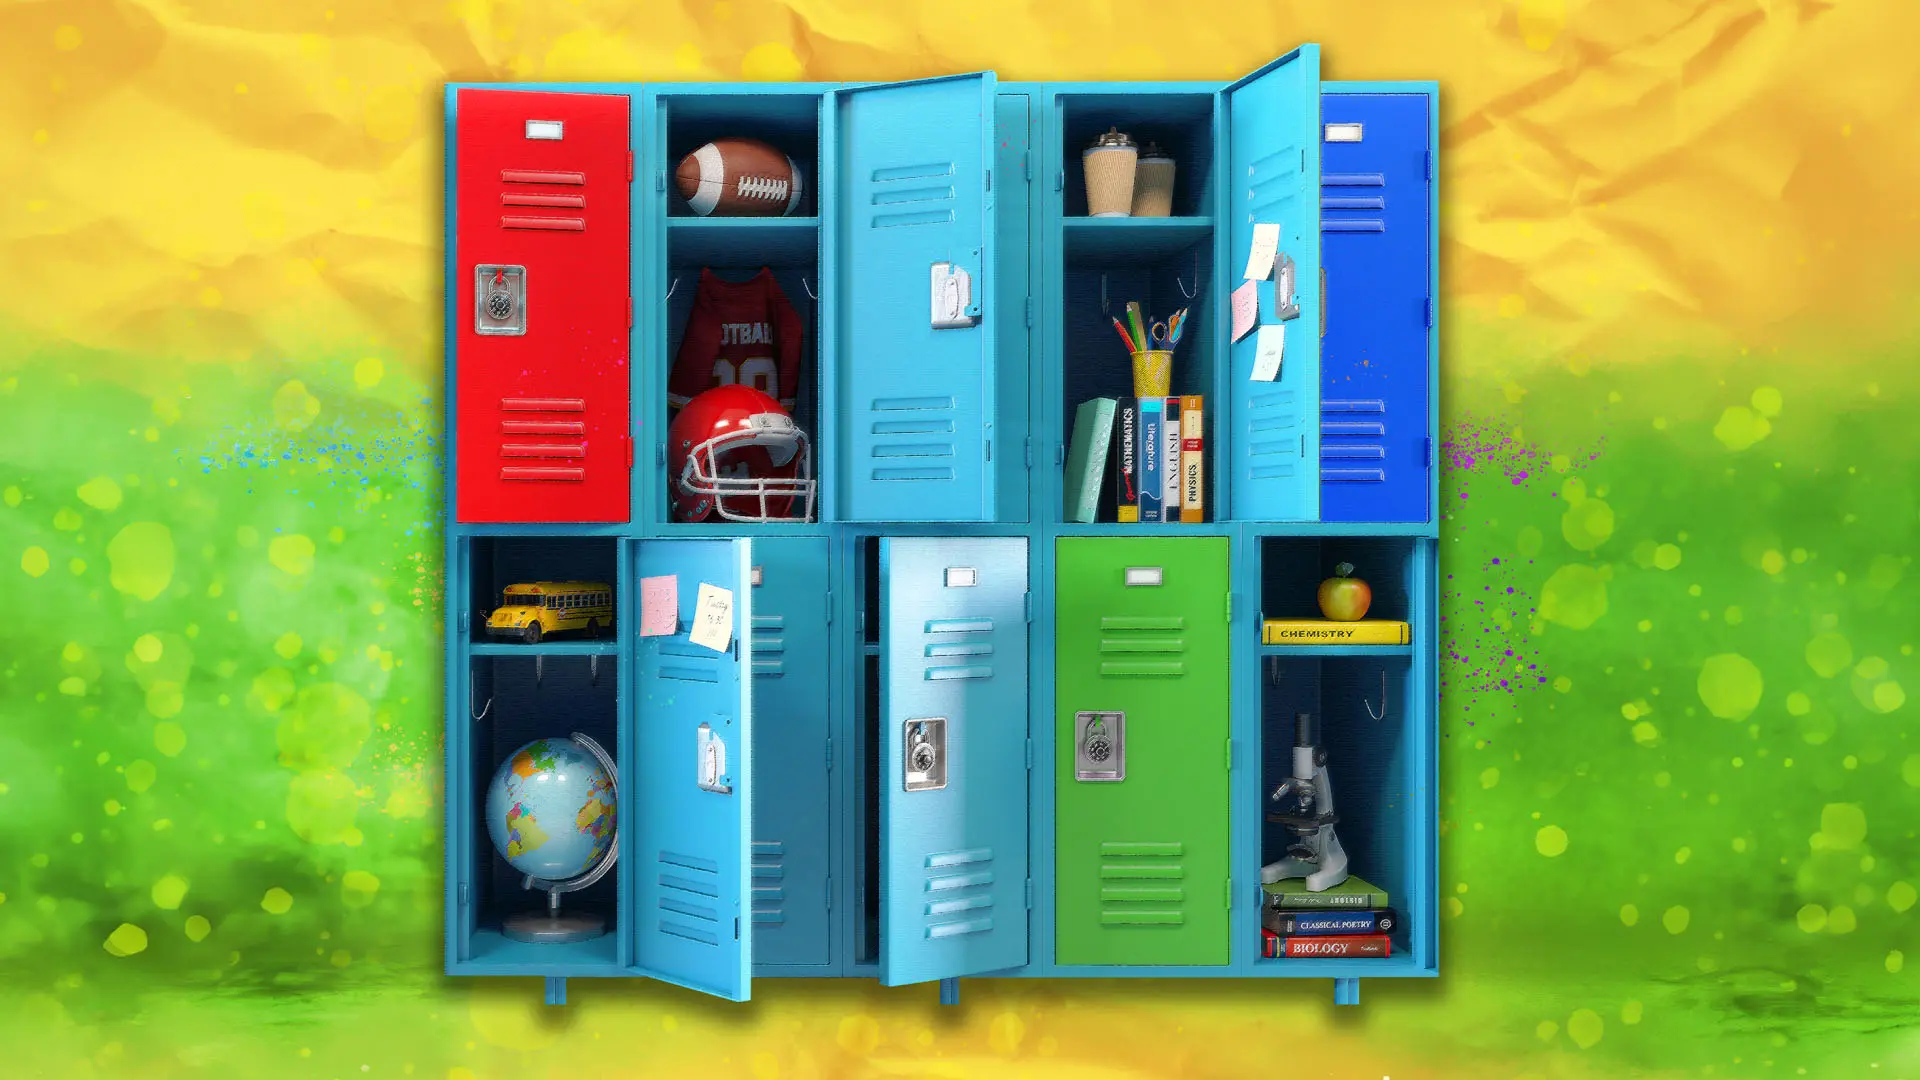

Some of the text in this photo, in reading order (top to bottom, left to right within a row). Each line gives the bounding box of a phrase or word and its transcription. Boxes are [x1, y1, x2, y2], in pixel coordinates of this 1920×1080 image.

[1123, 407, 1133, 474] MATHEMATICS
[1147, 423, 1156, 471] Literature
[1169, 433, 1178, 489] ENGLISH
[1188, 464, 1198, 502] PHYSICS
[1280, 629, 1354, 638] CHEMISTRY
[1300, 921, 1340, 930] CLASSICAL
[1342, 920, 1372, 929] POETRY
[1293, 943, 1349, 954] BIOLOGY
